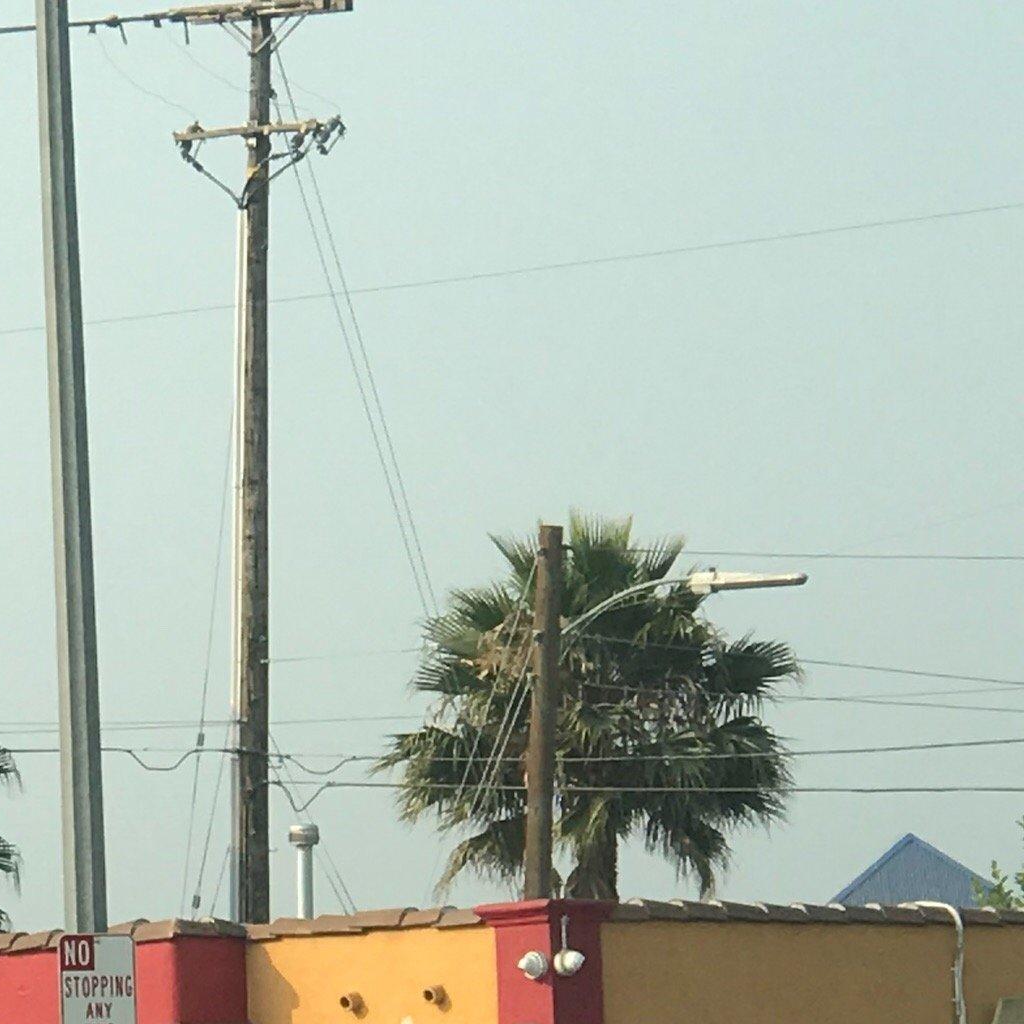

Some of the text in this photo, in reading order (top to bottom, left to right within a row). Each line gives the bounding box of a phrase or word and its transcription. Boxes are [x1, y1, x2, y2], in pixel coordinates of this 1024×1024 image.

[63, 939, 91, 966] NO
[64, 975, 134, 998] STOPPING
[85, 1002, 113, 1019] ANY
